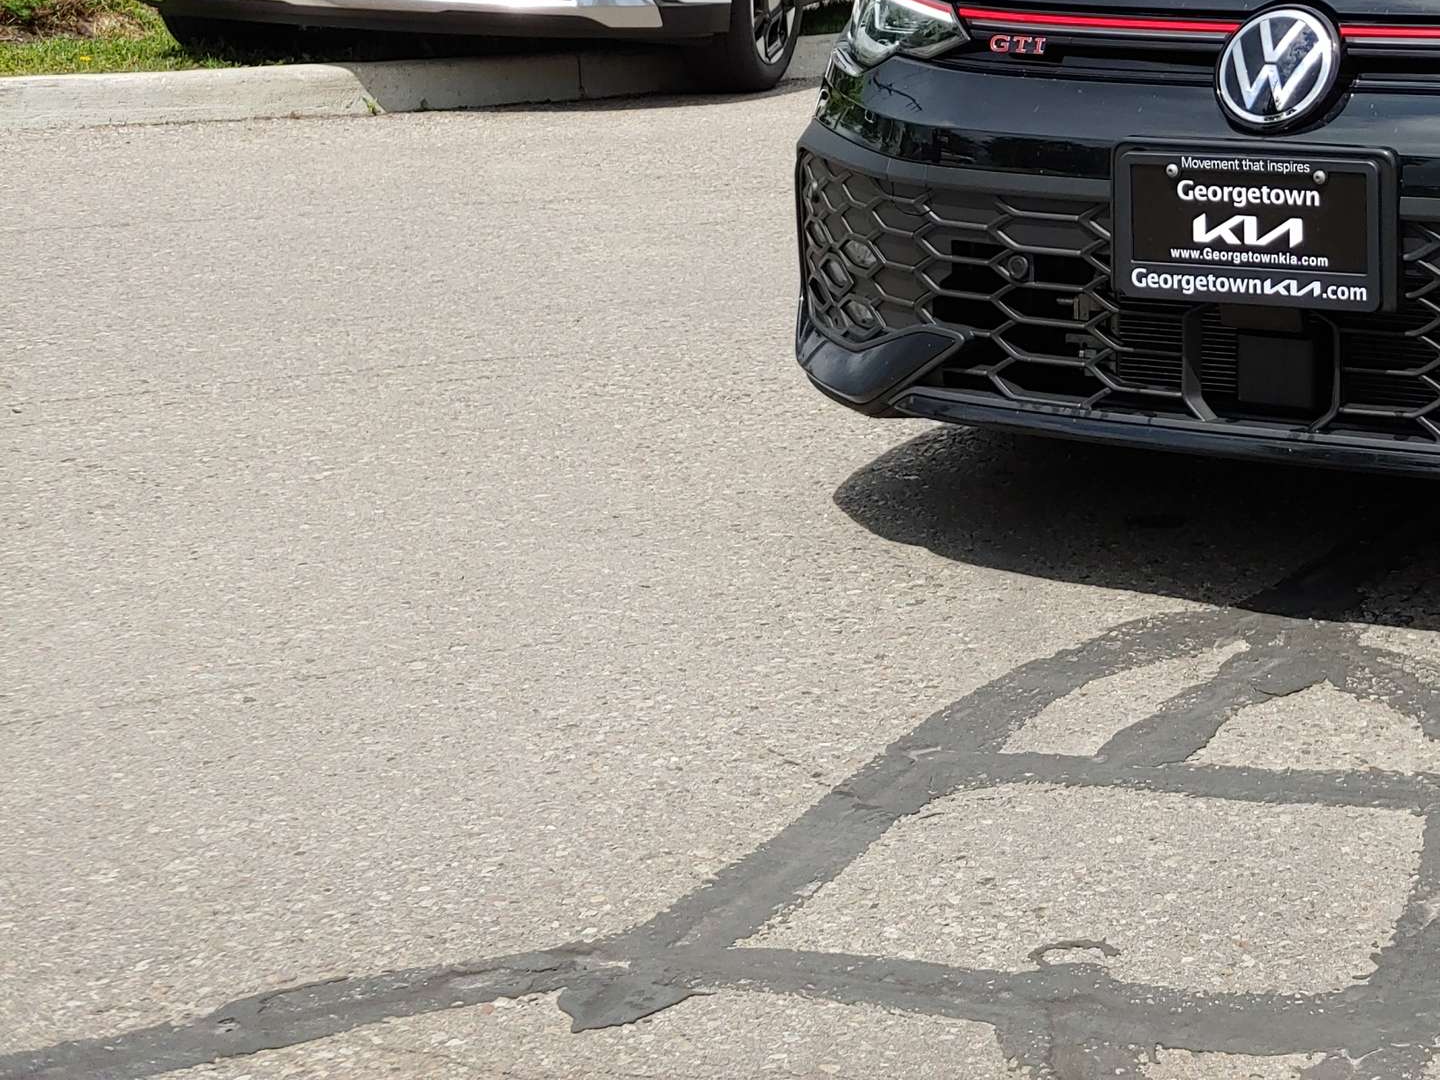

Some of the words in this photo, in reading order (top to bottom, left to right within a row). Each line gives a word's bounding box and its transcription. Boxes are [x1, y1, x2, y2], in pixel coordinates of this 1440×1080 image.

[989, 35, 1048, 56] GTI
[1180, 155, 1240, 171] Movement
[1242, 158, 1265, 172] that
[1266, 160, 1311, 175] inspires
[1176, 179, 1321, 208] Georgetown
[1192, 212, 1304, 249] KIA
[1170, 247, 1329, 268] www.Georgetownkia.com
